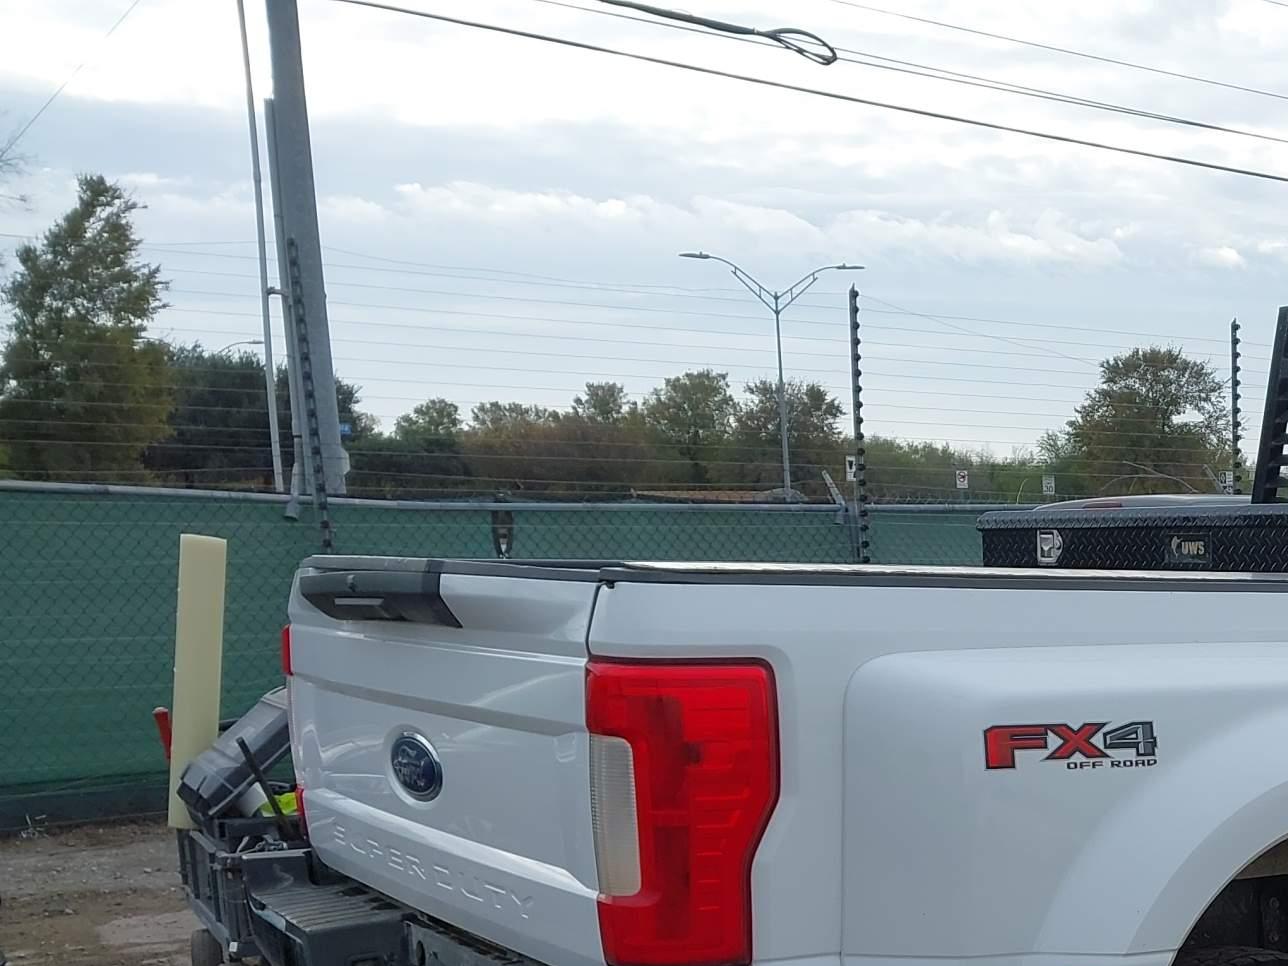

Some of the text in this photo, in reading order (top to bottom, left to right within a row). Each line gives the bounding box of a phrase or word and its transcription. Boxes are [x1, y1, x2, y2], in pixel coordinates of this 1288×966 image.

[1181, 541, 1205, 555] UWS
[984, 721, 1158, 770] FX4
[1066, 758, 1158, 770] OFF ROAD
[334, 825, 535, 920] SUPER DUTY
